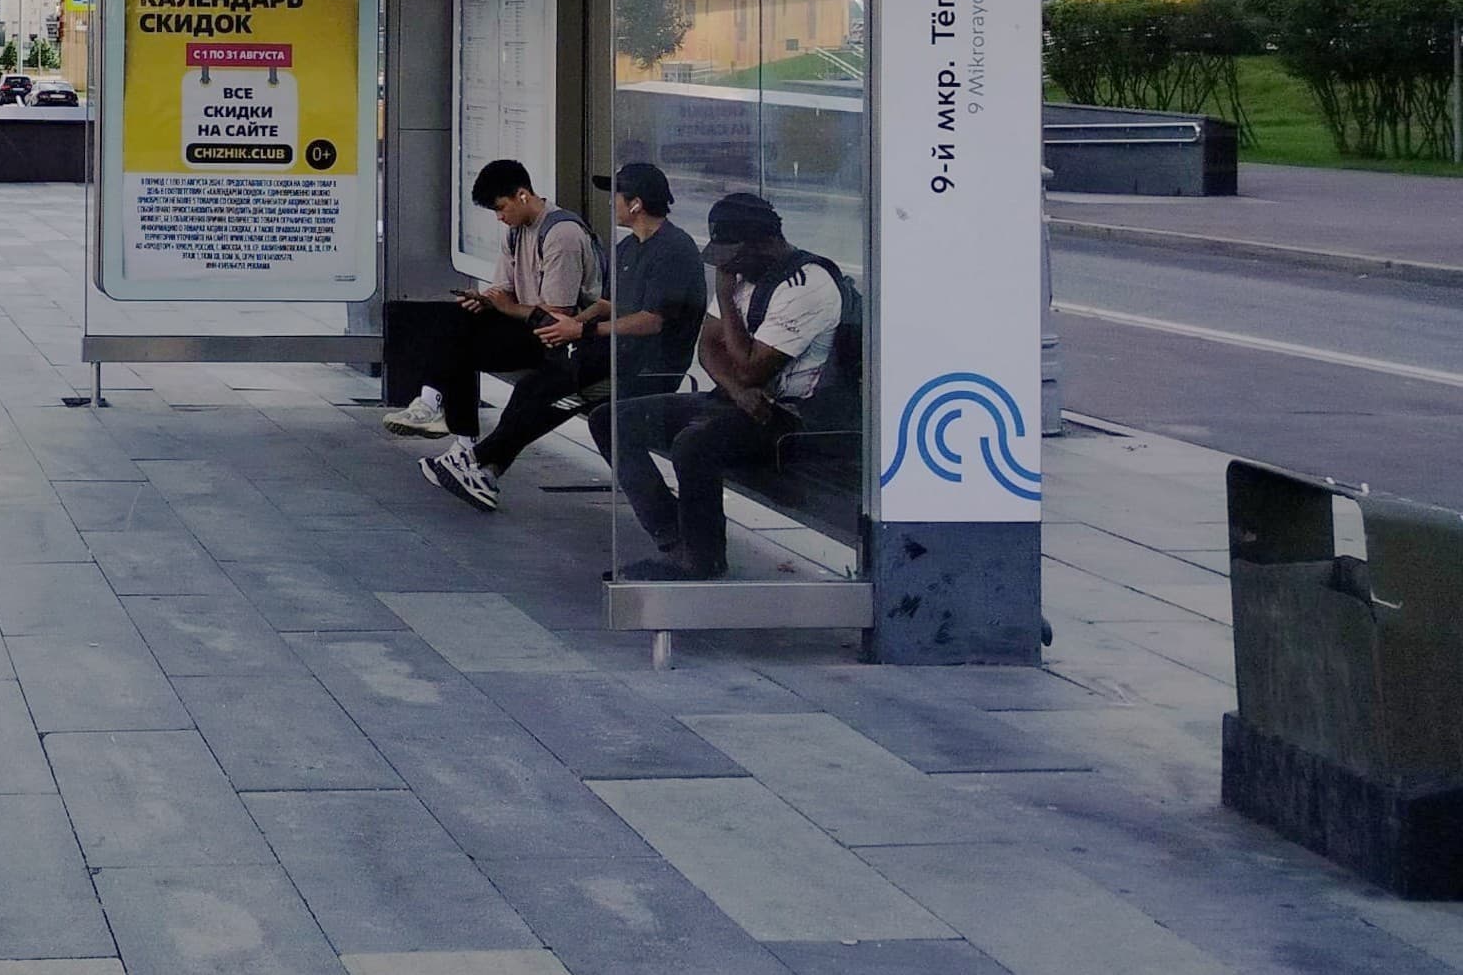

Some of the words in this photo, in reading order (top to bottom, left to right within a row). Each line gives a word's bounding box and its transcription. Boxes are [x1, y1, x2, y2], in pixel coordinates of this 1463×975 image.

[139, 13, 253, 37] СКИДОК
[193, 50, 200, 60] С
[202, 50, 207, 60] 1
[209, 50, 225, 60] ПО
[226, 50, 238, 60] 31
[239, 50, 285, 60] АВГУСТА
[223, 87, 253, 99] ВСЕ
[935, 60, 961, 132] мкр.
[203, 106, 273, 120] СКИДКИ
[967, 101, 984, 114] 9
[198, 124, 221, 137] НА
[225, 121, 279, 137] САЙТЕ
[193, 147, 285, 159] CHIZHIK.CLUB
[312, 146, 331, 162] 0+
[931, 144, 956, 194] 9-й
